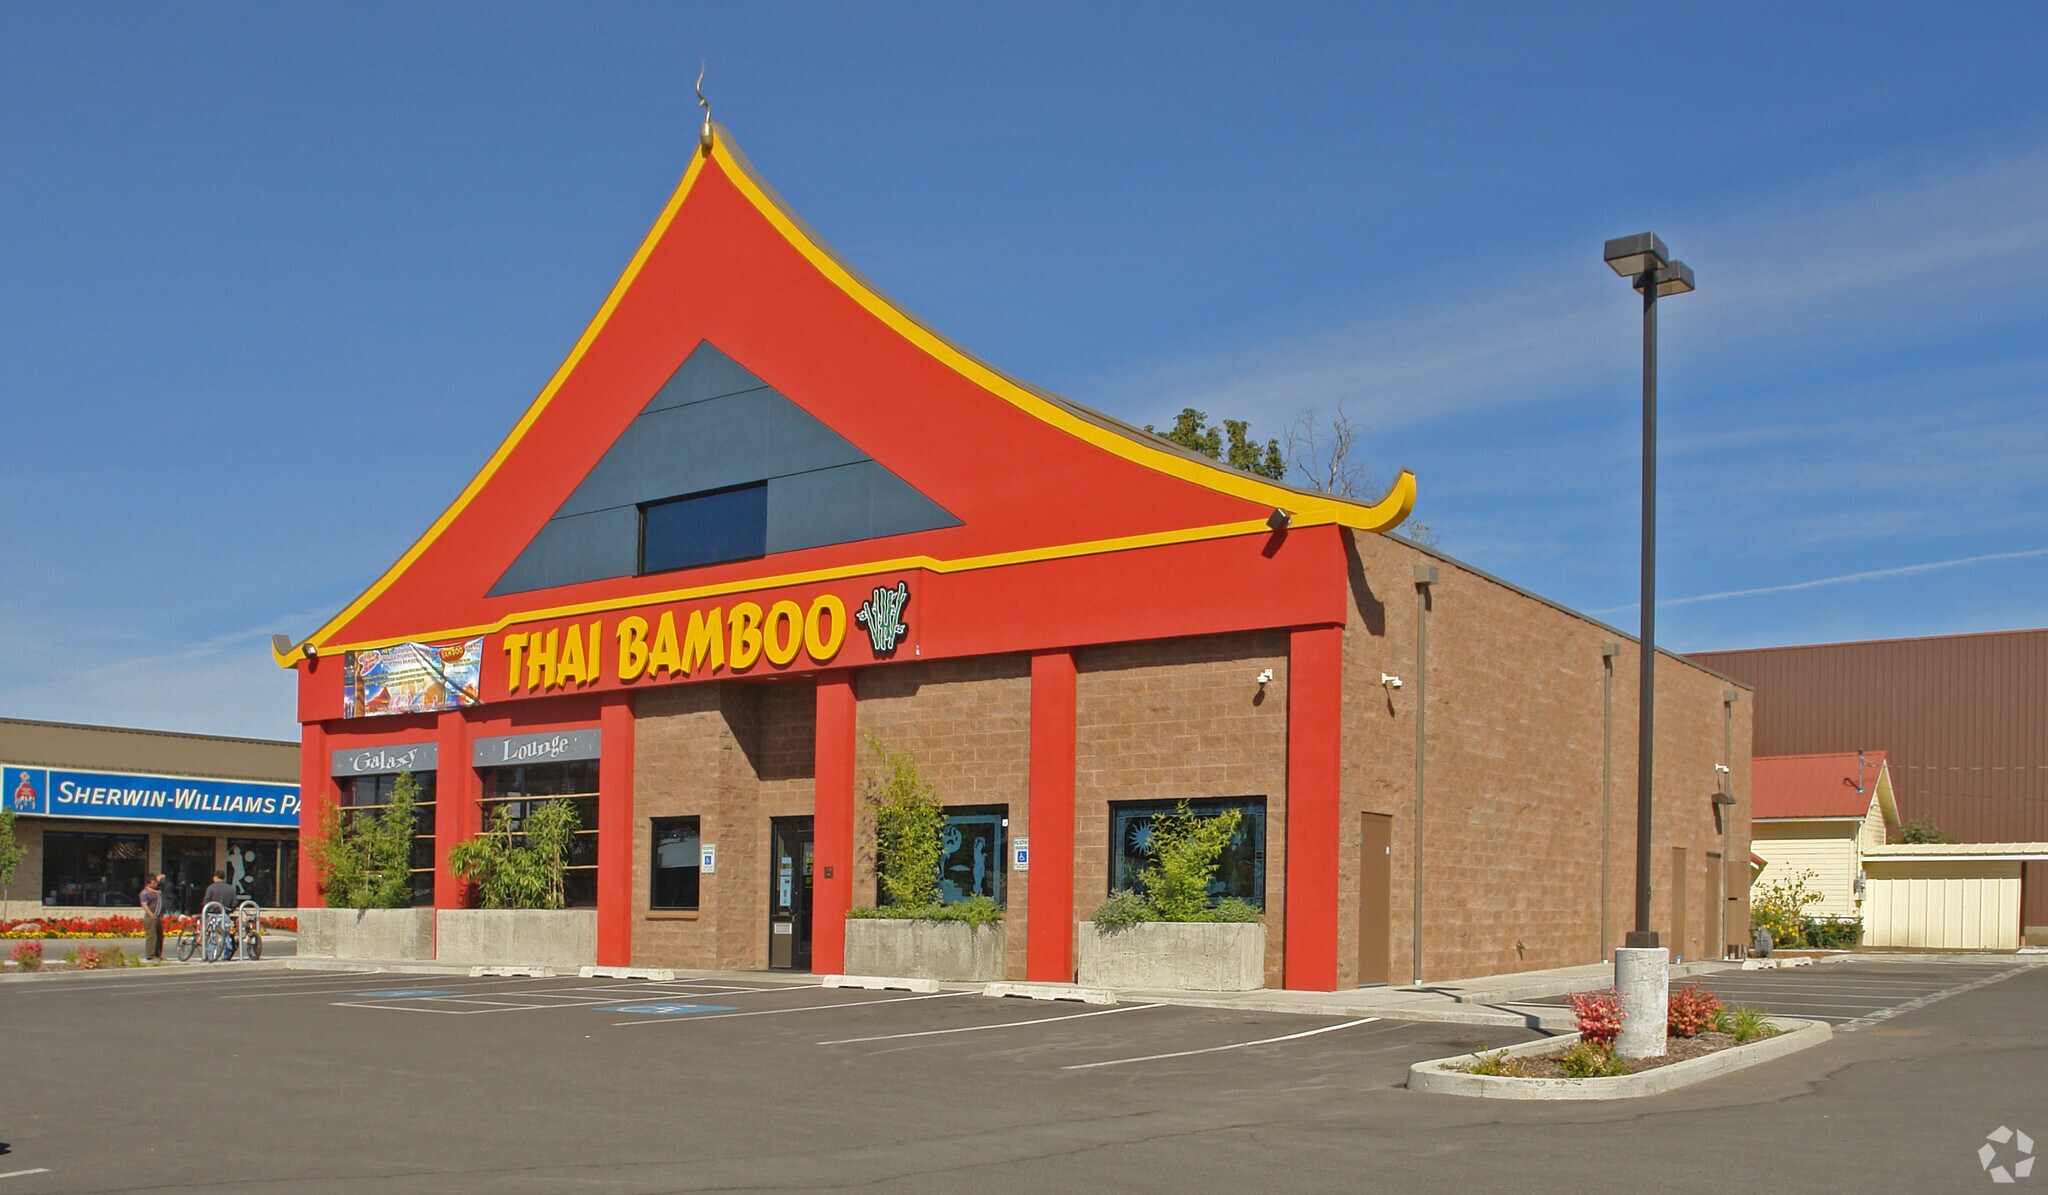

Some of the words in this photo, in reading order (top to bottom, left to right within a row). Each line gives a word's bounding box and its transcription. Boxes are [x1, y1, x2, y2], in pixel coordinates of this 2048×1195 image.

[503, 621, 602, 692] THAI
[616, 594, 846, 680] BAMBOO
[353, 747, 419, 772] Galaxy
[502, 735, 569, 761] Lounge
[57, 781, 276, 814] SHERWIN-WILLIAMS
